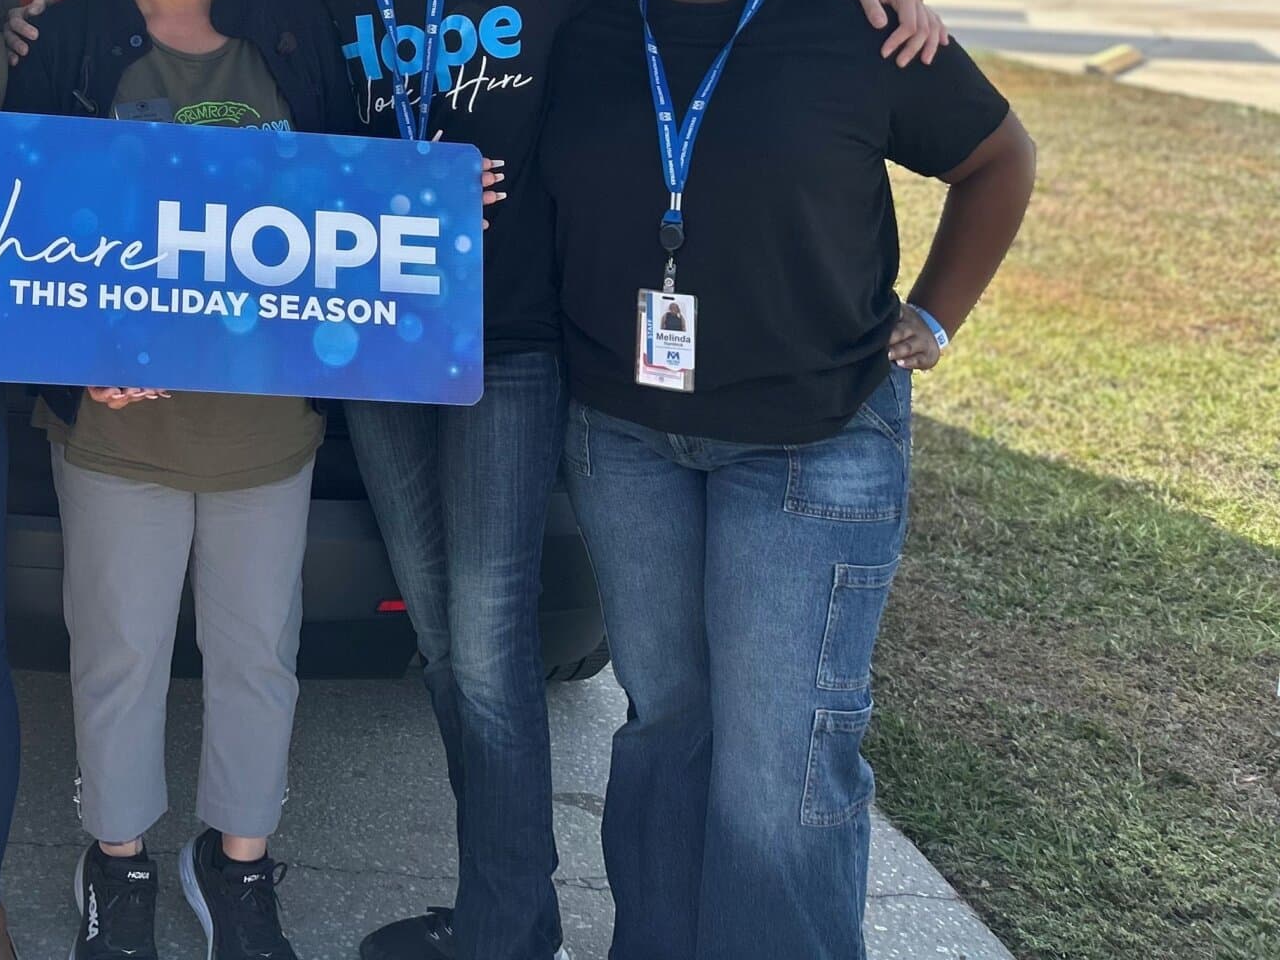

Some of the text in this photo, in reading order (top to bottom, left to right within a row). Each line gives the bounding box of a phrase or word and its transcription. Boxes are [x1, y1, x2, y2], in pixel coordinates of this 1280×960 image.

[176, 105, 247, 125] PRIMROSE
[9, 279, 396, 325] THIS HOLIDAY SEASON
[656, 332, 691, 344] Melinda
